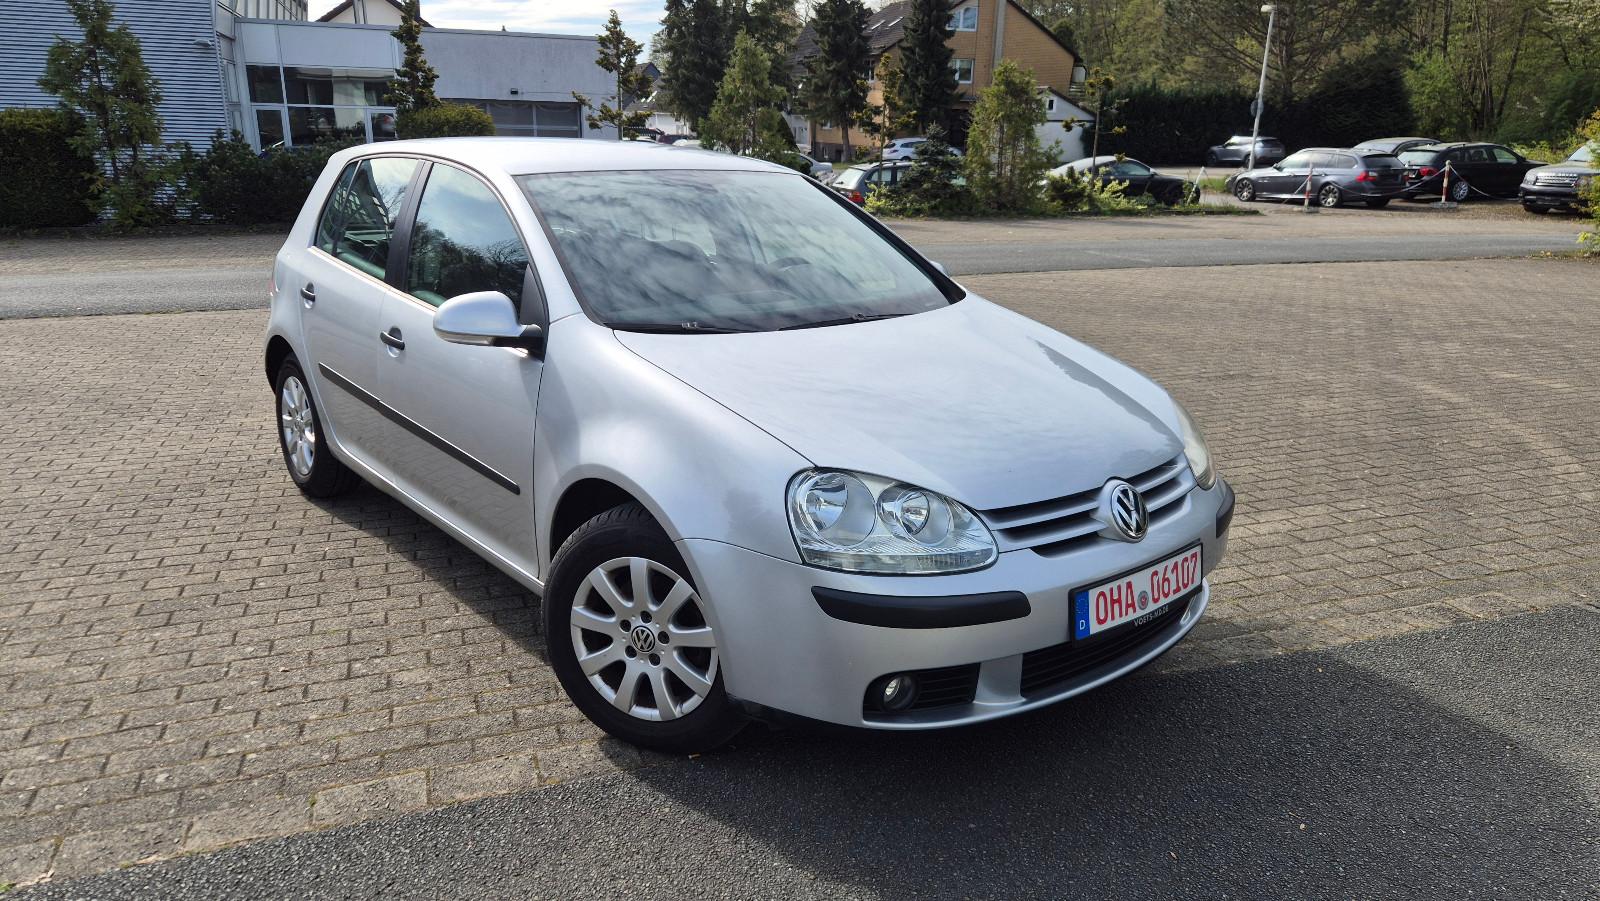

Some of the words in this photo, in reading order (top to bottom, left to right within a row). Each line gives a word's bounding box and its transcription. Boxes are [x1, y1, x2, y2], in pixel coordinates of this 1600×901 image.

[1113, 485, 1146, 537] VW
[1095, 580, 1137, 625] OHA
[1150, 551, 1198, 604] 06107
[632, 627, 654, 651] VW
[1079, 619, 1086, 631] D
